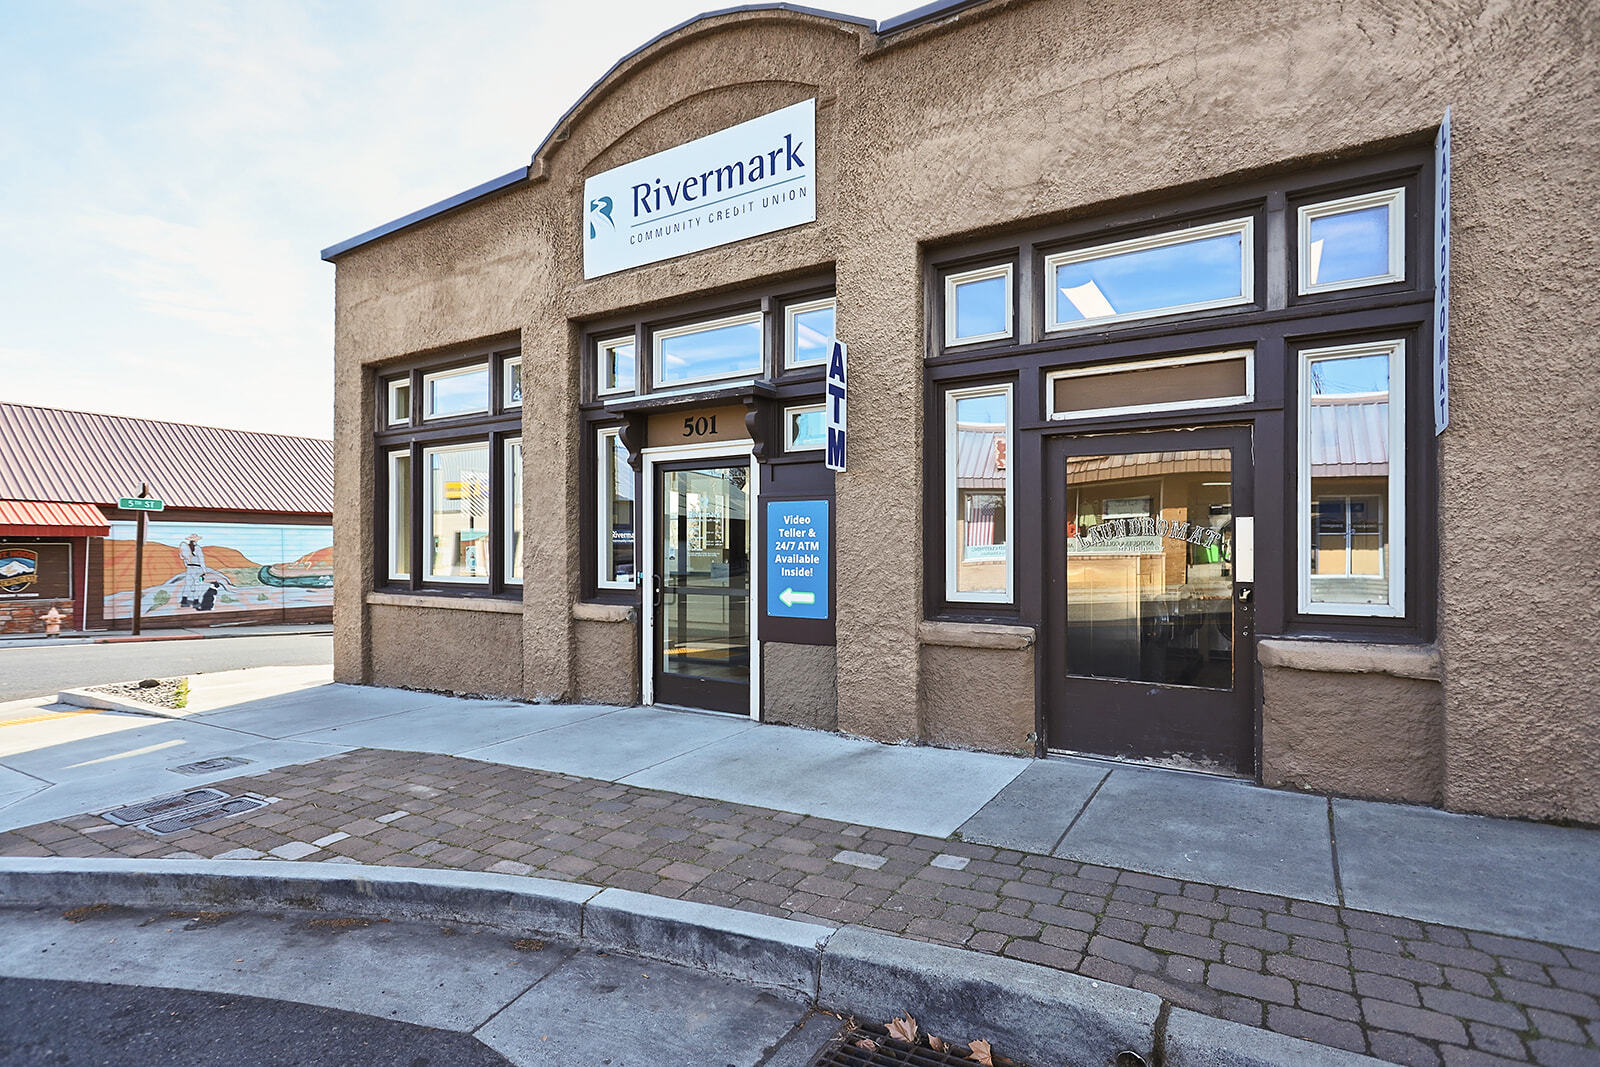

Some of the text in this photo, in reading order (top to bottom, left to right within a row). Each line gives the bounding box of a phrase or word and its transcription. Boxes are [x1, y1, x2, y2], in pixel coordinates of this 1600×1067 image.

[631, 133, 805, 218] Rivermark
[629, 186, 808, 245] COMMUNITY CREDIT UNION
[1439, 123, 1448, 425] LAUNDROMAT
[827, 341, 846, 469] ATM
[682, 414, 719, 437] 501
[144, 500, 155, 508] ST
[783, 514, 811, 525] Video
[778, 527, 817, 538] Teller &
[1073, 515, 1222, 550] LAUNDROMAT
[775, 541, 820, 551] 24/7 ATM
[774, 553, 820, 564] Available
[781, 566, 814, 577] Inside!
